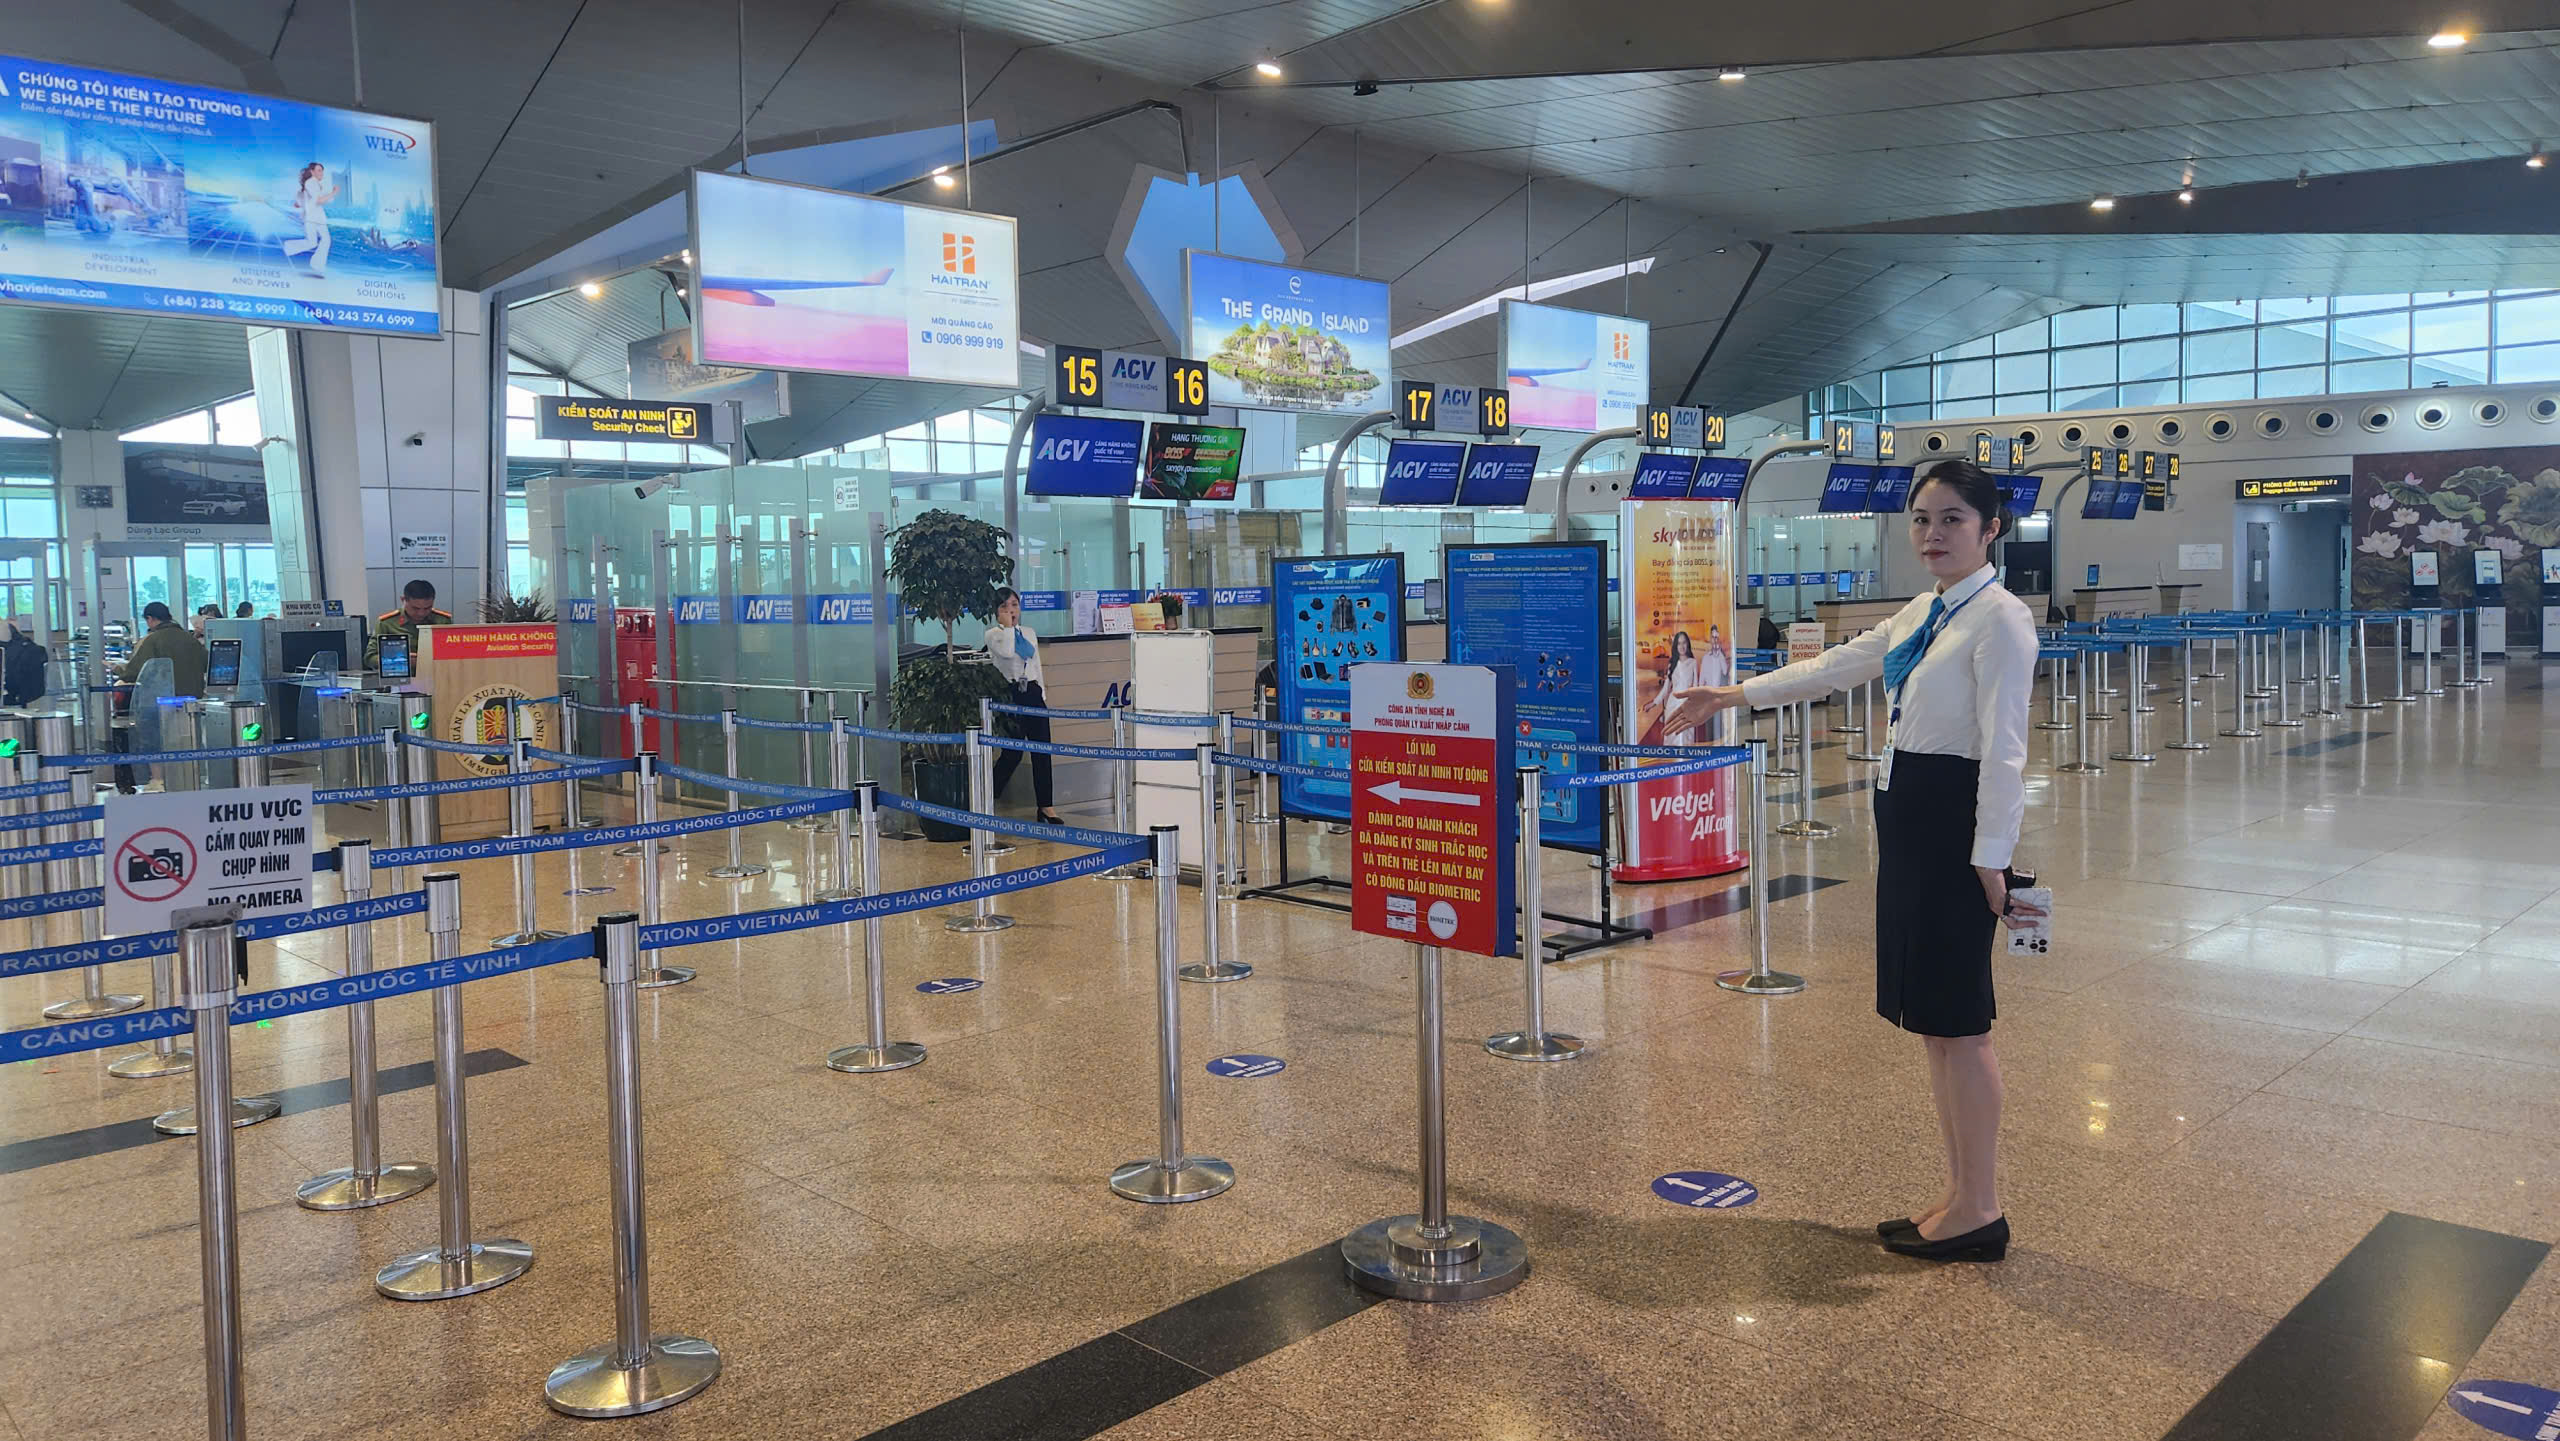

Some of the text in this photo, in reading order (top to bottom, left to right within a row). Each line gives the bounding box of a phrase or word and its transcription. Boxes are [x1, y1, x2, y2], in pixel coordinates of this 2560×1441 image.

[18, 71, 78, 91] CHÚNG
[82, 80, 109, 96] TÔI
[152, 92, 184, 109] TẠO
[187, 96, 243, 117] TƯƠNG
[246, 106, 270, 121] LAI
[20, 87, 47, 101] WE
[51, 92, 106, 111] SHAPE
[109, 101, 140, 116] THE
[144, 105, 206, 126] FUTURE
[365, 135, 407, 154] WHA
[364, 279, 397, 290] DIGITAL
[931, 274, 988, 289] HAITRAN
[164, 294, 197, 309] (+84)
[201, 297, 224, 310] 238
[228, 300, 252, 312] 222
[256, 302, 286, 315] 9999
[337, 310, 360, 322] 243
[363, 312, 384, 324] 574
[387, 314, 415, 327] 6999
[1221, 297, 1369, 334] THE GRAND ISLAND
[936, 332, 1004, 350] 0906 999 919
[1063, 355, 1204, 406] 15 ACV 16
[557, 402, 666, 421] KIỂM SOÁT AN NINH
[1407, 389, 1432, 422] 17
[1441, 388, 1472, 407] ACV
[1484, 396, 1507, 428] 18
[592, 421, 666, 434] Security Check
[1651, 411, 1669, 439] 19
[1674, 410, 1697, 426] ACV
[1707, 416, 1724, 443] 20
[1171, 433, 1190, 444] HẠNG
[1838, 426, 1894, 454] 21 22
[1036, 437, 1090, 462] ACV
[1978, 440, 2023, 464] 23 24
[1389, 461, 1427, 479] ACV
[1468, 461, 1504, 480] ACV
[2091, 450, 2128, 472] 25 26
[2145, 455, 2179, 476] 27 28
[1637, 469, 1667, 486] ACV
[1696, 472, 1724, 488] ACV
[1828, 477, 1852, 492] ACV
[1874, 479, 1894, 493] ACV
[172, 526, 201, 537] Group
[1214, 590, 1236, 604] ACV
[680, 600, 704, 621] ACV
[746, 599, 774, 620] ACV
[820, 599, 851, 621] ACV
[446, 634, 461, 643] AN
[463, 634, 487, 643] NINH
[489, 631, 517, 642] HÀNG
[486, 643, 554, 652] Aviation Security
[1388, 704, 1455, 718] CÔNG AN TỈNH NGHỆ AN
[1374, 717, 1470, 732] PHÒNG QUẢN LÝ XUẤT NHẬP CẢNH
[1406, 738, 1436, 757] LỐI VÀO
[1358, 756, 1489, 785] CỬA KIỂM SOÁT AN NINH TỰ ĐỘNG
[1569, 753, 1738, 786] ACV AIRPORTS CORPORATION OF VIETNAM
[209, 798, 303, 823] KHU VỰC
[1650, 788, 1715, 822] Vietjet
[1395, 815, 1414, 829] CHO
[1416, 816, 1443, 832] HÀNH
[1445, 819, 1478, 837] KHÁCH
[205, 827, 305, 852] CẤM QUAY PHIM
[1359, 829, 1488, 862] ĐÃ ĐĂNG KÝ SINH TRẮC HỌC
[222, 851, 290, 879] CHỤP HÌNH
[1362, 850, 1485, 881] VÀ TRÊN THẺ LÊN MÁY BAY
[704, 854, 1105, 935] OF VIETNAM CẢNG HÀNG KHÔNG QUỐC TẾ VINH
[1365, 871, 1481, 903] CÓ ĐÓNG DẤU BIOMETRIC
[241, 888, 303, 909] CAMERA
[21, 952, 522, 1051] CẢNG HÀN KHÔNG QUỐC TẾ VINH
